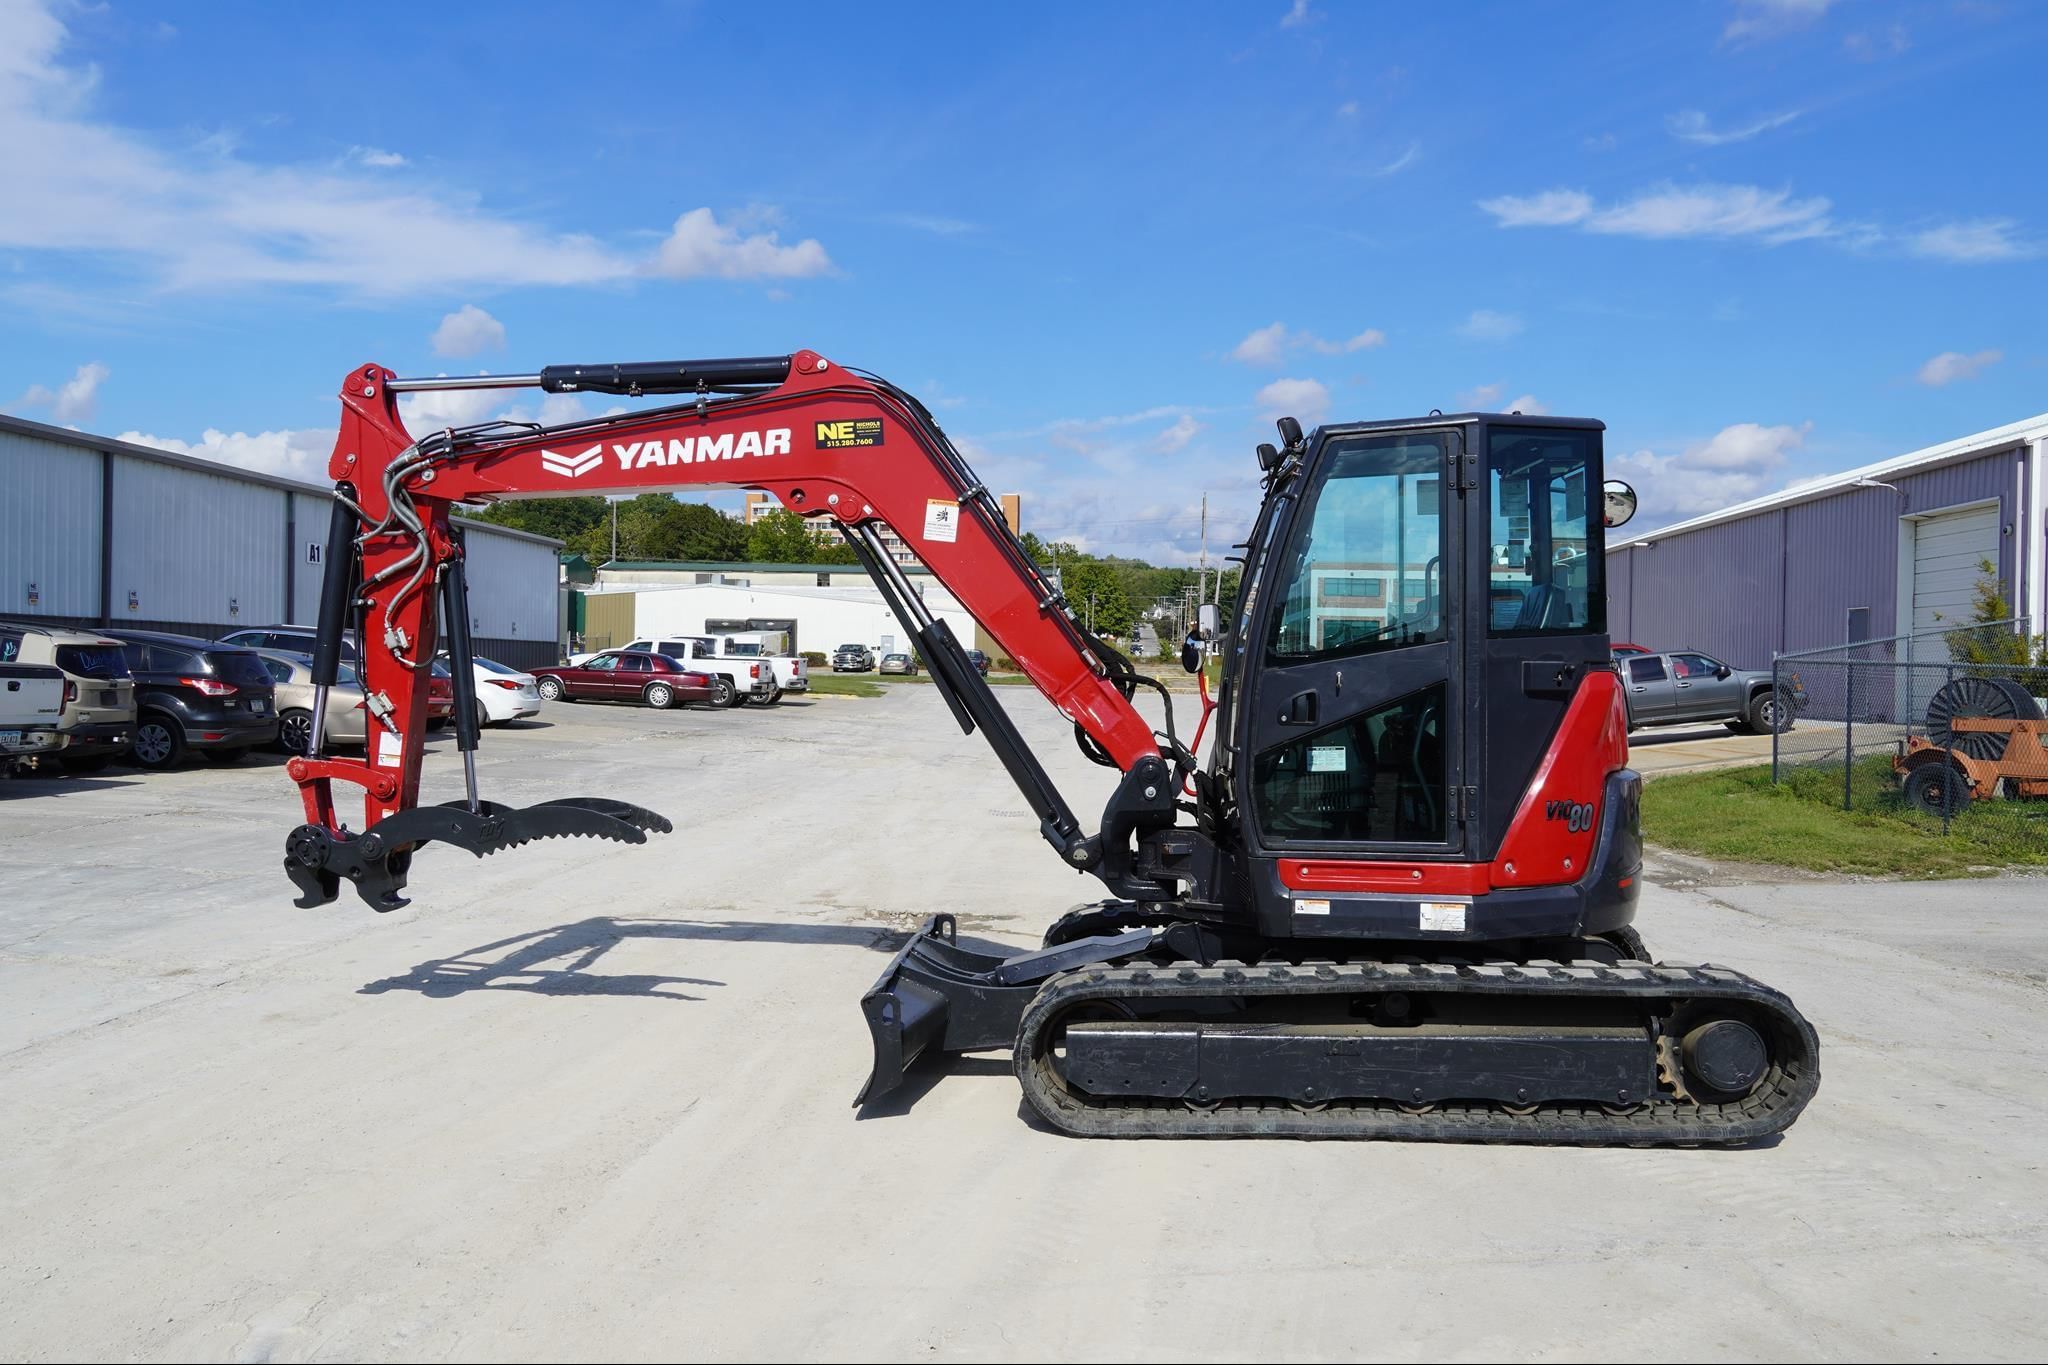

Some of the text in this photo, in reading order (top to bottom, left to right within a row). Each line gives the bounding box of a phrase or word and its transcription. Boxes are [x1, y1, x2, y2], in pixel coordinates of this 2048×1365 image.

[817, 422, 854, 440] NE
[612, 428, 791, 470] YANMAR
[827, 438, 873, 447] 515.280.7600
[309, 544, 320, 562] A1
